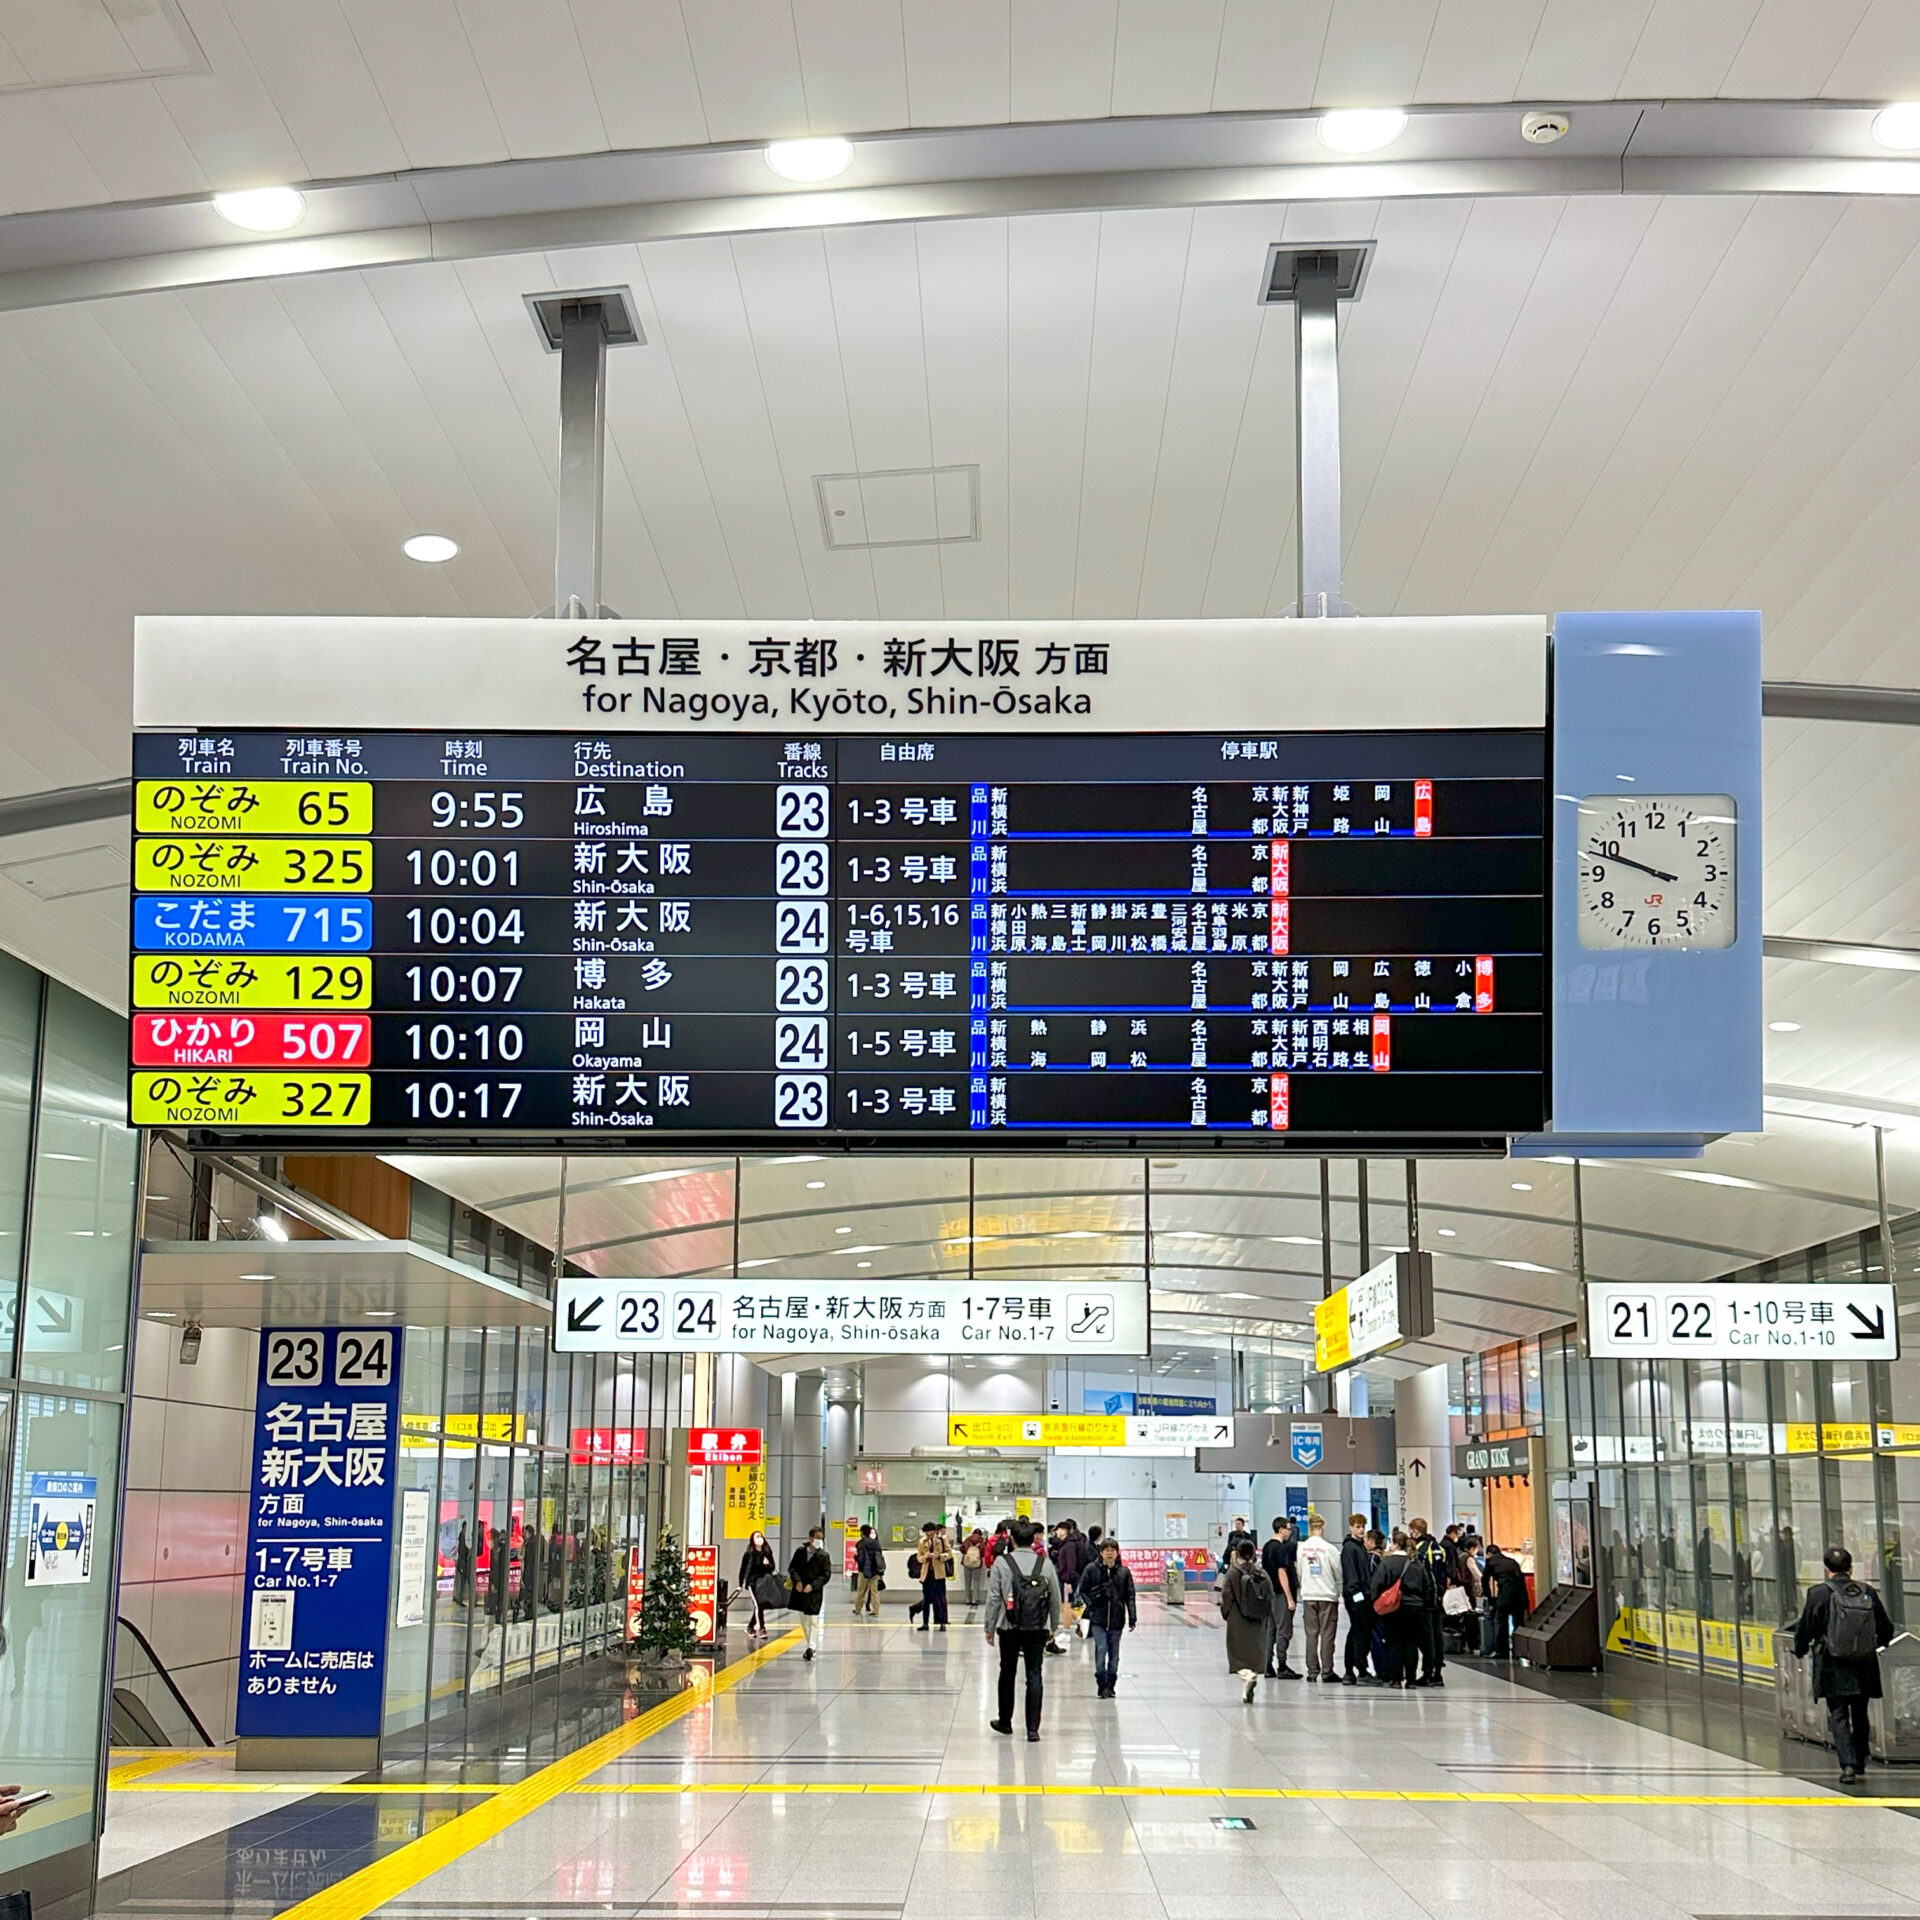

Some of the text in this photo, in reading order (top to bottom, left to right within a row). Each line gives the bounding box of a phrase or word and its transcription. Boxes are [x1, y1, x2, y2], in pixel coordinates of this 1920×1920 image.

[567, 636, 1109, 677] 名古屋・京都・新大阪 方面
[583, 684, 1090, 721] for Nagoya, Kyōto, Shin-Ōsaka
[179, 738, 1278, 761] 列車名 列車番号 時刻 行先 番線 自由席 停車駅
[182, 758, 827, 778] Train Train No. Time Destination Tracks
[154, 784, 957, 831] のぞみ 65 9:55 広島 23 1-3 号車
[172, 817, 648, 835] NOZOMI Hiroshima
[1618, 821, 1635, 837] 11
[1645, 813, 1665, 829] 12
[1678, 821, 1685, 837] 1
[1599, 841, 1619, 856] 10
[1697, 840, 1708, 856] 2
[153, 842, 956, 889] のぞみ 325 10:01 新大阪 23 1-3 号車
[1593, 866, 1604, 882] 9
[1705, 865, 1716, 881] 3
[171, 875, 654, 893] NOZOMI Shin-Ōsaka
[1601, 892, 1614, 908] 8
[1644, 894, 1663, 905] JR
[1694, 892, 1707, 907] 4
[156, 900, 959, 946] こだま 715 10:04 新大阪 24 1-6,15,16
[972, 905, 986, 950] 品川
[991, 903, 1007, 951] 新横浜
[1011, 904, 1026, 951] 小田原
[1031, 904, 1047, 951] 熱海
[1051, 905, 1067, 951] 三島
[1071, 904, 1087, 950] 新富士
[1091, 904, 1107, 951] 静岡
[1111, 904, 1127, 951] 掛川
[1131, 904, 1147, 951] 浜松
[1151, 904, 1167, 951] 豊橋
[1171, 904, 1187, 951] 三河安城
[1192, 903, 1207, 950] 名古屋
[1232, 903, 1248, 951] 米原
[1252, 903, 1268, 951] 京都
[1272, 902, 1288, 950] 新大阪
[1623, 911, 1634, 927] 7
[1648, 918, 1660, 935] 6
[1677, 910, 1688, 927] 5
[166, 933, 654, 951] KODAMA Shin-Ōsaka
[846, 929, 893, 953] 号車
[151, 958, 956, 1004] のぞみ 129 10:07 博多 23 1-3 号車
[170, 991, 625, 1009] NOZOMI Hakata
[152, 1017, 956, 1062] ひかり 507 10:10 岡山 24 1-5 号車
[971, 1019, 1389, 1069] 品川 新横浜 熱海 静岡 浜松 名古屋 京都 新大阪 新神戸 西明石 姫路 相生 岡山
[175, 1050, 641, 1070] HIKARI Okayama
[149, 1074, 956, 1120] のぞみ 327 10:17 新大阪 23 1-3 号車
[168, 1108, 653, 1125] NOZOMI Shin-Ōsaka
[621, 1296, 1050, 1333] 23 24 名古屋・新大阪 方面 1-7号車
[1614, 1301, 1834, 1337] 21 22 1-10号車
[733, 1325, 1054, 1343] for Nagoya, Shin-ōsaka Car No.1-7
[1730, 1330, 1834, 1345] Car No.1-10
[269, 1338, 387, 1379] 23 24
[265, 1402, 387, 1442] 名古屋
[705, 1453, 742, 1462] Ekiben
[261, 1447, 385, 1487] 新大阪
[259, 1494, 304, 1514] 方面
[258, 1517, 382, 1528] for Nagoya, Shin-ōsaka
[256, 1547, 352, 1572] 1-7号車
[255, 1575, 337, 1587] Car No.1-7
[250, 1651, 374, 1669] ホームに売店は
[248, 1676, 336, 1694] ありません
